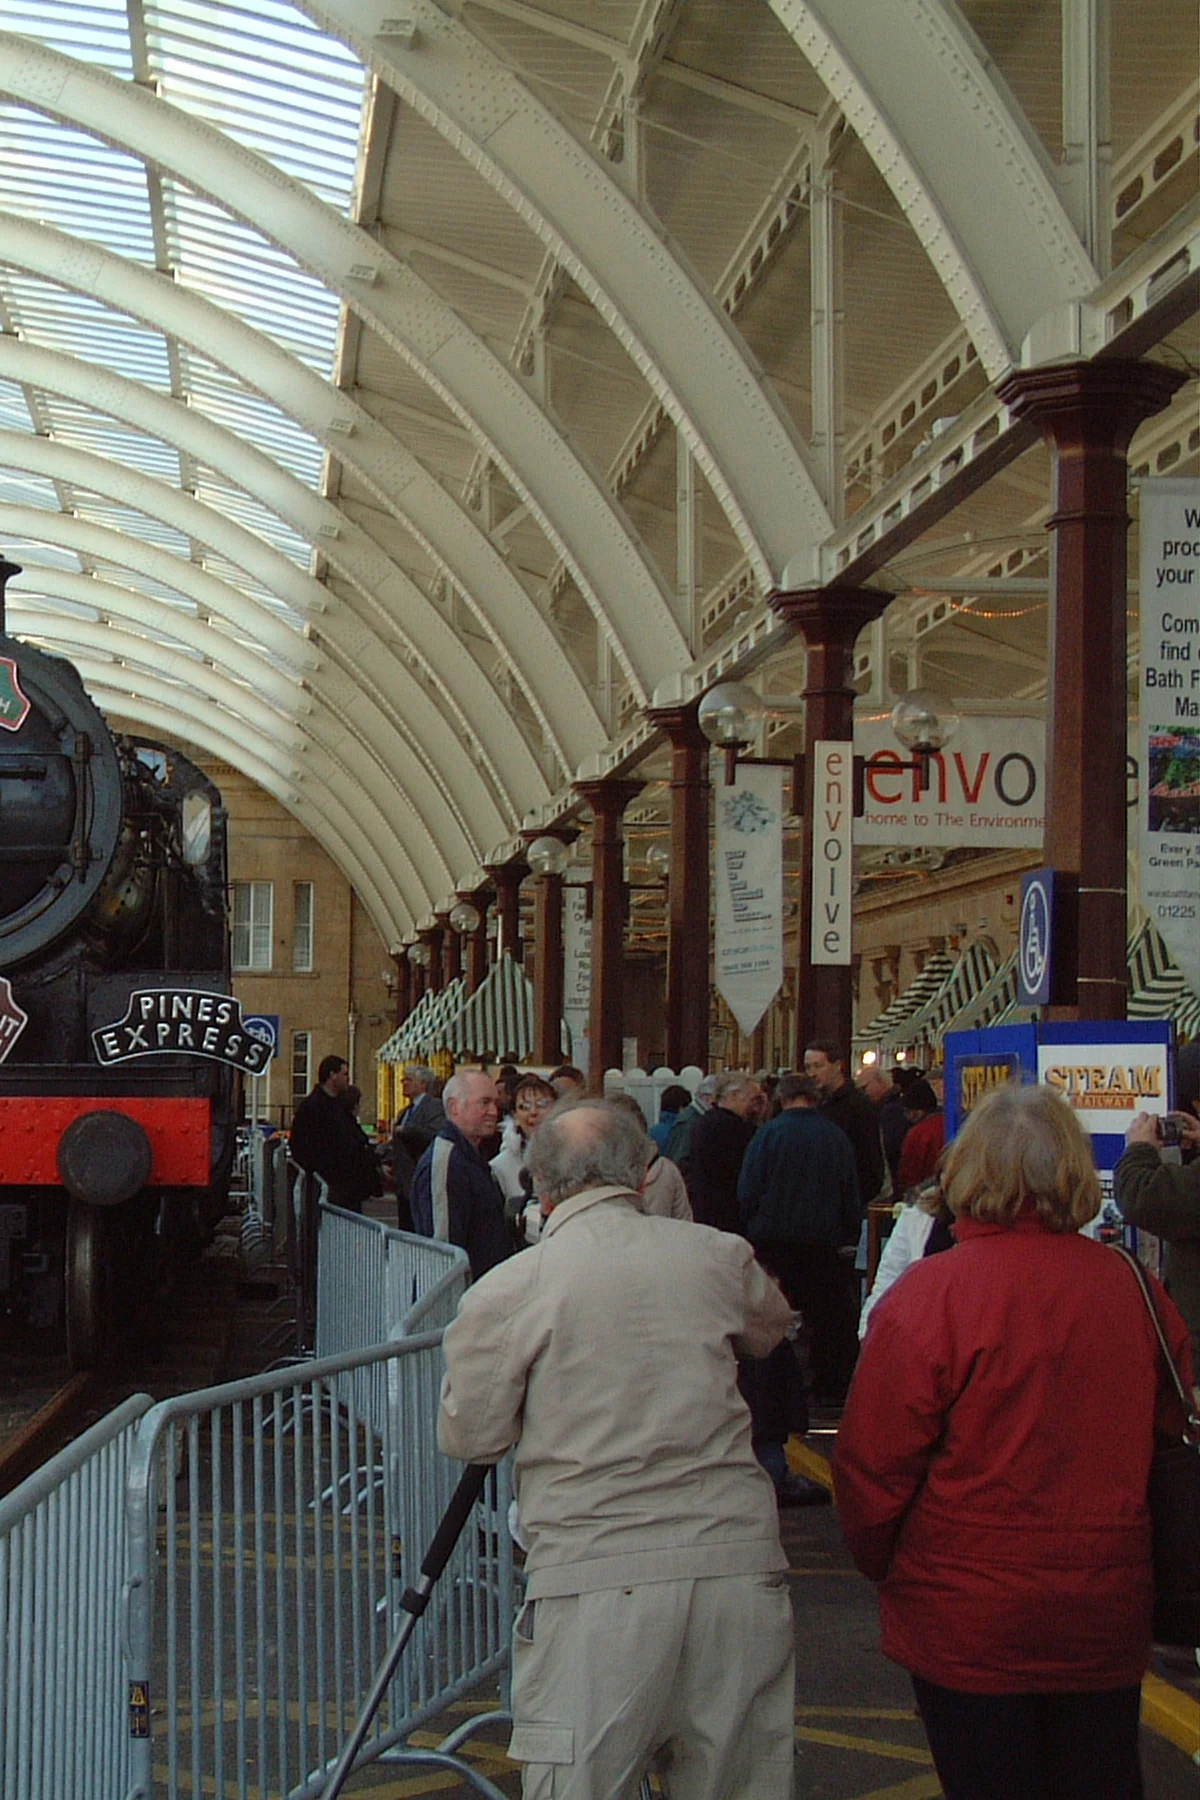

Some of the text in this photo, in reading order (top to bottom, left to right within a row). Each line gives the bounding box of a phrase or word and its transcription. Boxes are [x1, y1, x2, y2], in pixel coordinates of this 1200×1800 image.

[1156, 567, 1195, 588] your
[1160, 641, 1191, 660] find
[1146, 668, 1183, 688] Bath
[865, 811, 1045, 829] home to The Environme
[823, 752, 843, 953] envolve
[1158, 904, 1196, 919] 01225
[140, 996, 232, 1025] PINES
[102, 1023, 263, 1065] EXPRESS
[1045, 1065, 1161, 1098] STEAM
